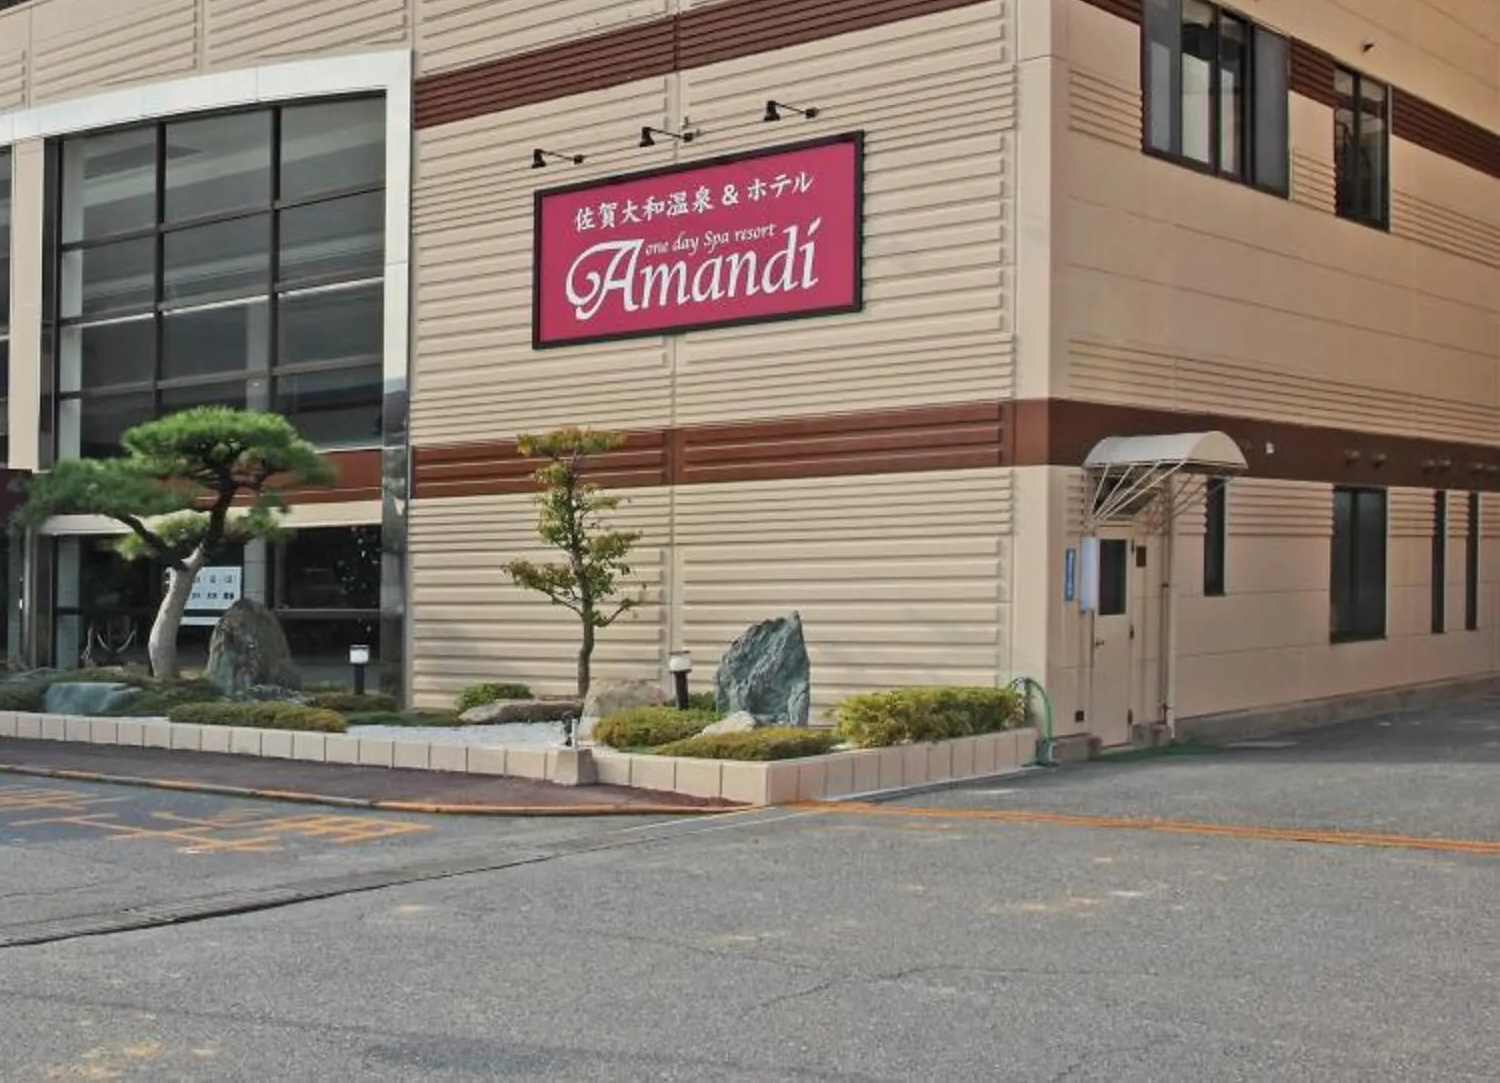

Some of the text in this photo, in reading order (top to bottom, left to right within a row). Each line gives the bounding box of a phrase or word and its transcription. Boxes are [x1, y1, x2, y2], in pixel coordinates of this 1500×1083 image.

[575, 171, 813, 232] 佐賀大和温泉 & ホテル
[645, 222, 777, 256] one day Spa resort
